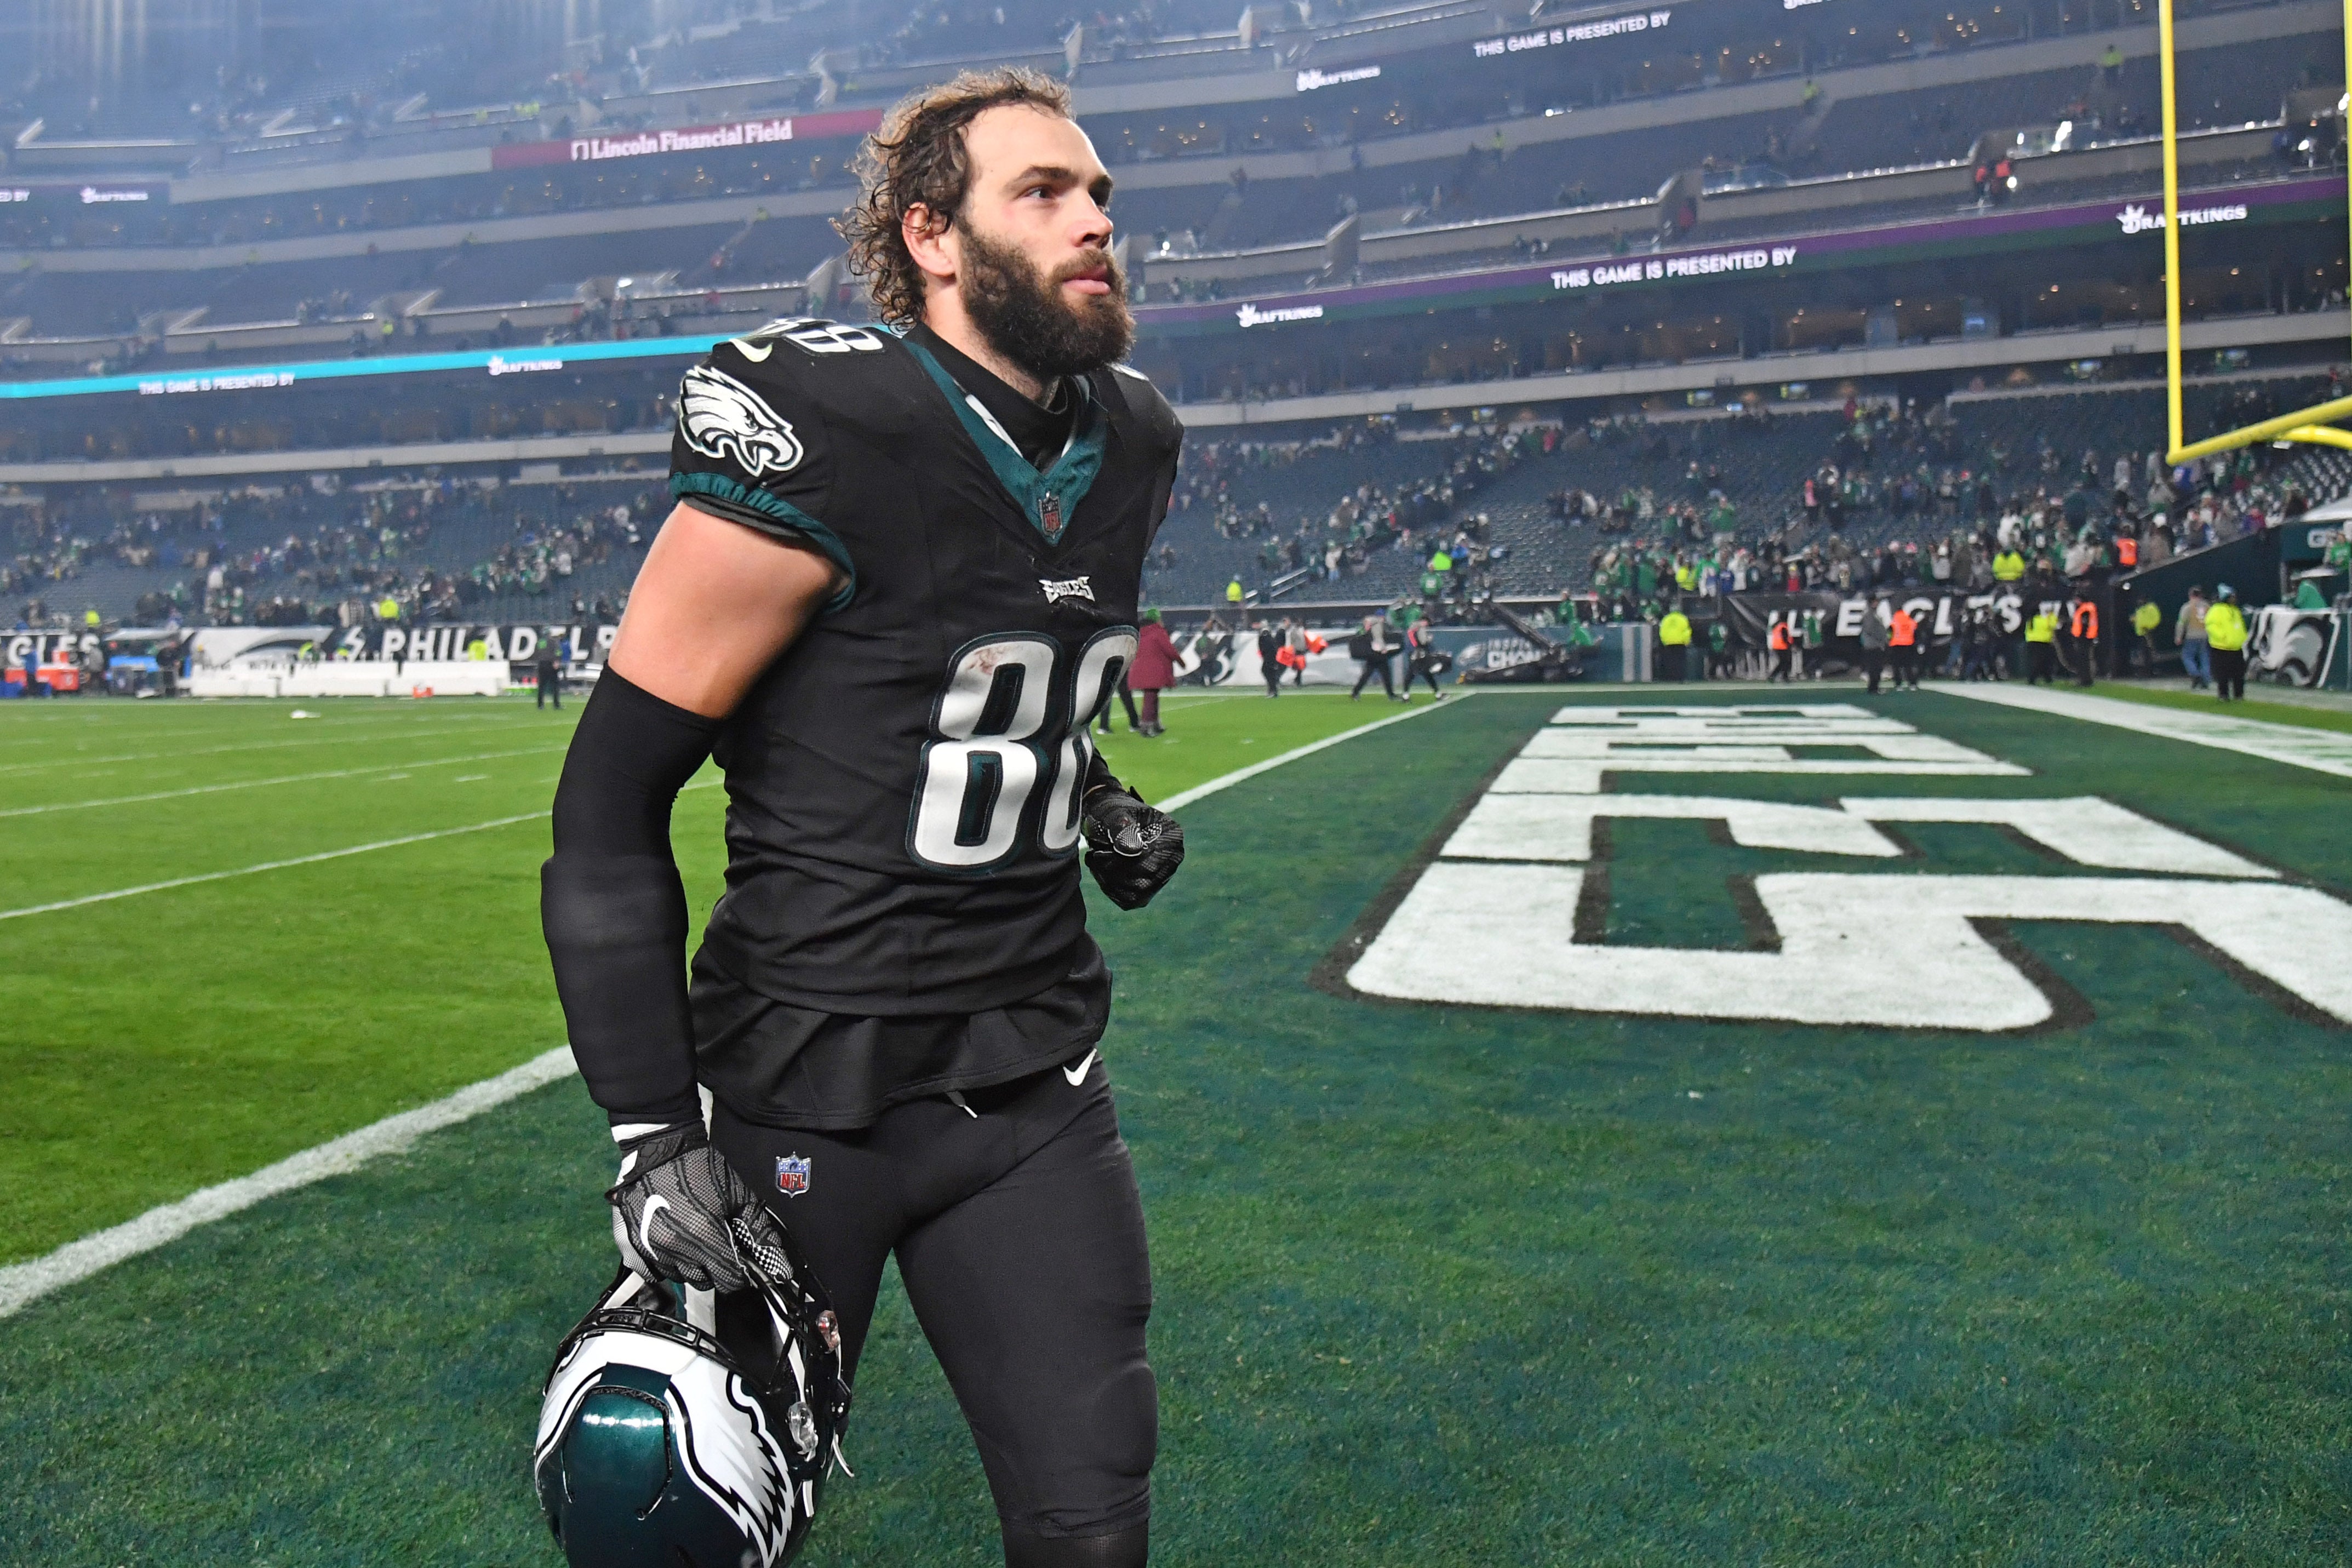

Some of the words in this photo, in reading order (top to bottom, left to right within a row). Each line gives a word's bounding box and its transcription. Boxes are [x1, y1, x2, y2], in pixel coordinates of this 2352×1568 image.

[1473, 39, 1506, 57] THIS
[1507, 31, 1548, 51] GAME
[1549, 28, 1564, 45] IS
[1566, 14, 1649, 42] PRESENTED
[1650, 10, 1671, 28] BY
[591, 133, 658, 159] Lincoln
[659, 124, 743, 152] Financial
[744, 118, 793, 144] Field
[2116, 203, 2248, 234] DRATKINGS
[1550, 270, 1590, 289] THIS
[1592, 262, 1644, 285] GAME
[1645, 260, 1663, 280] IS
[1666, 250, 1768, 278] PRESENTED
[1772, 246, 1796, 267] BY
[1039, 576, 1095, 604] EAGLES
[906, 625, 1140, 874] 88
[780, 1172, 805, 1189] NFL
